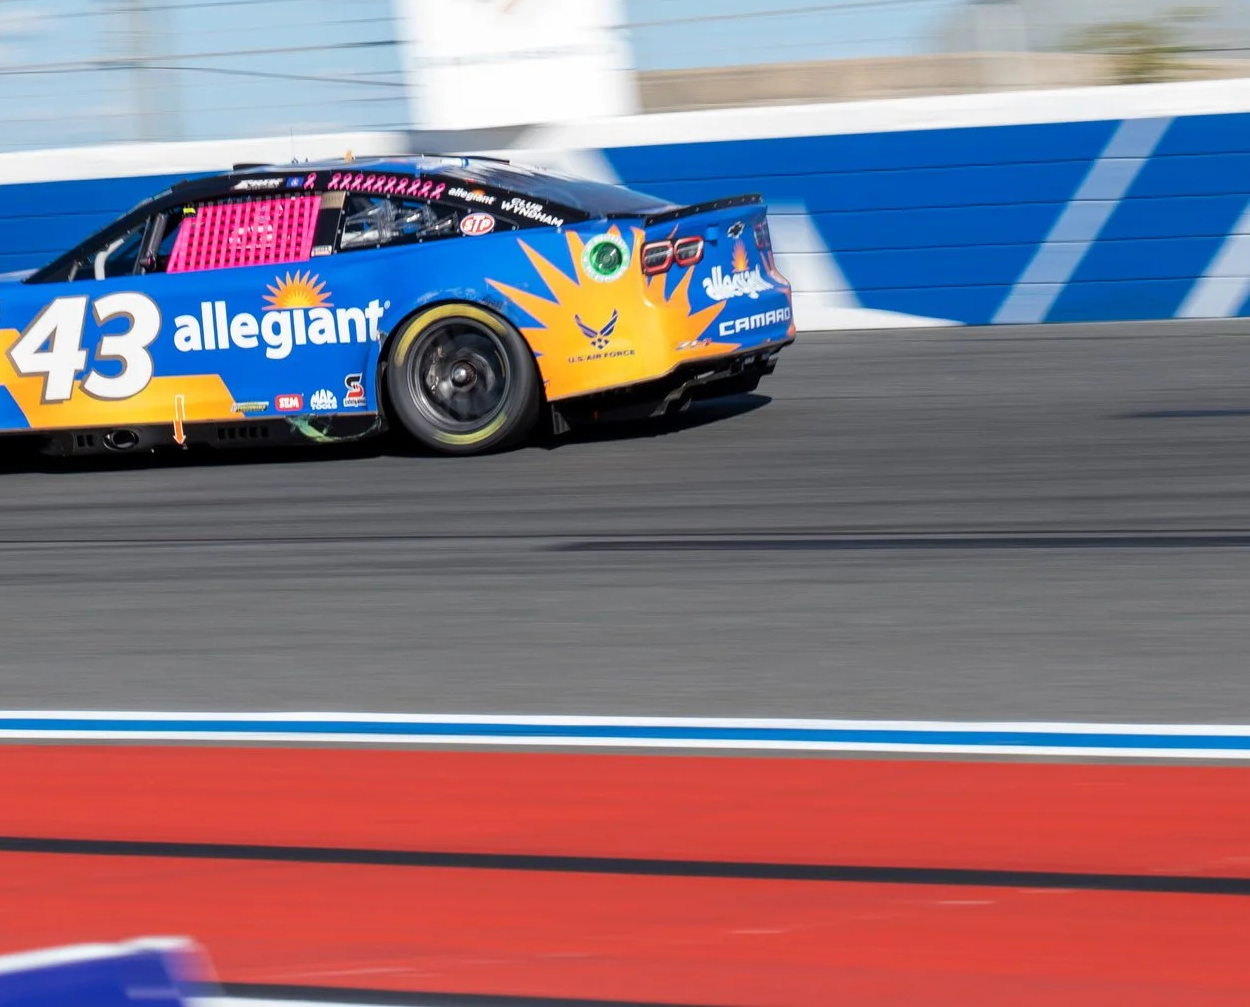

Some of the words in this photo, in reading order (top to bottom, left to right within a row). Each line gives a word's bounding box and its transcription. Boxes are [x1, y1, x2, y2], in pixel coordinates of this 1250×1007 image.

[448, 187, 496, 205] allegiant
[511, 197, 544, 213] CLUB
[501, 200, 564, 227] WYNDHAM
[462, 214, 492, 233] STP
[173, 299, 386, 360] allegiant
[718, 307, 791, 337] CAMARO
[7, 291, 162, 404] 43
[603, 350, 636, 360] FORCE
[279, 397, 299, 409] SEM
